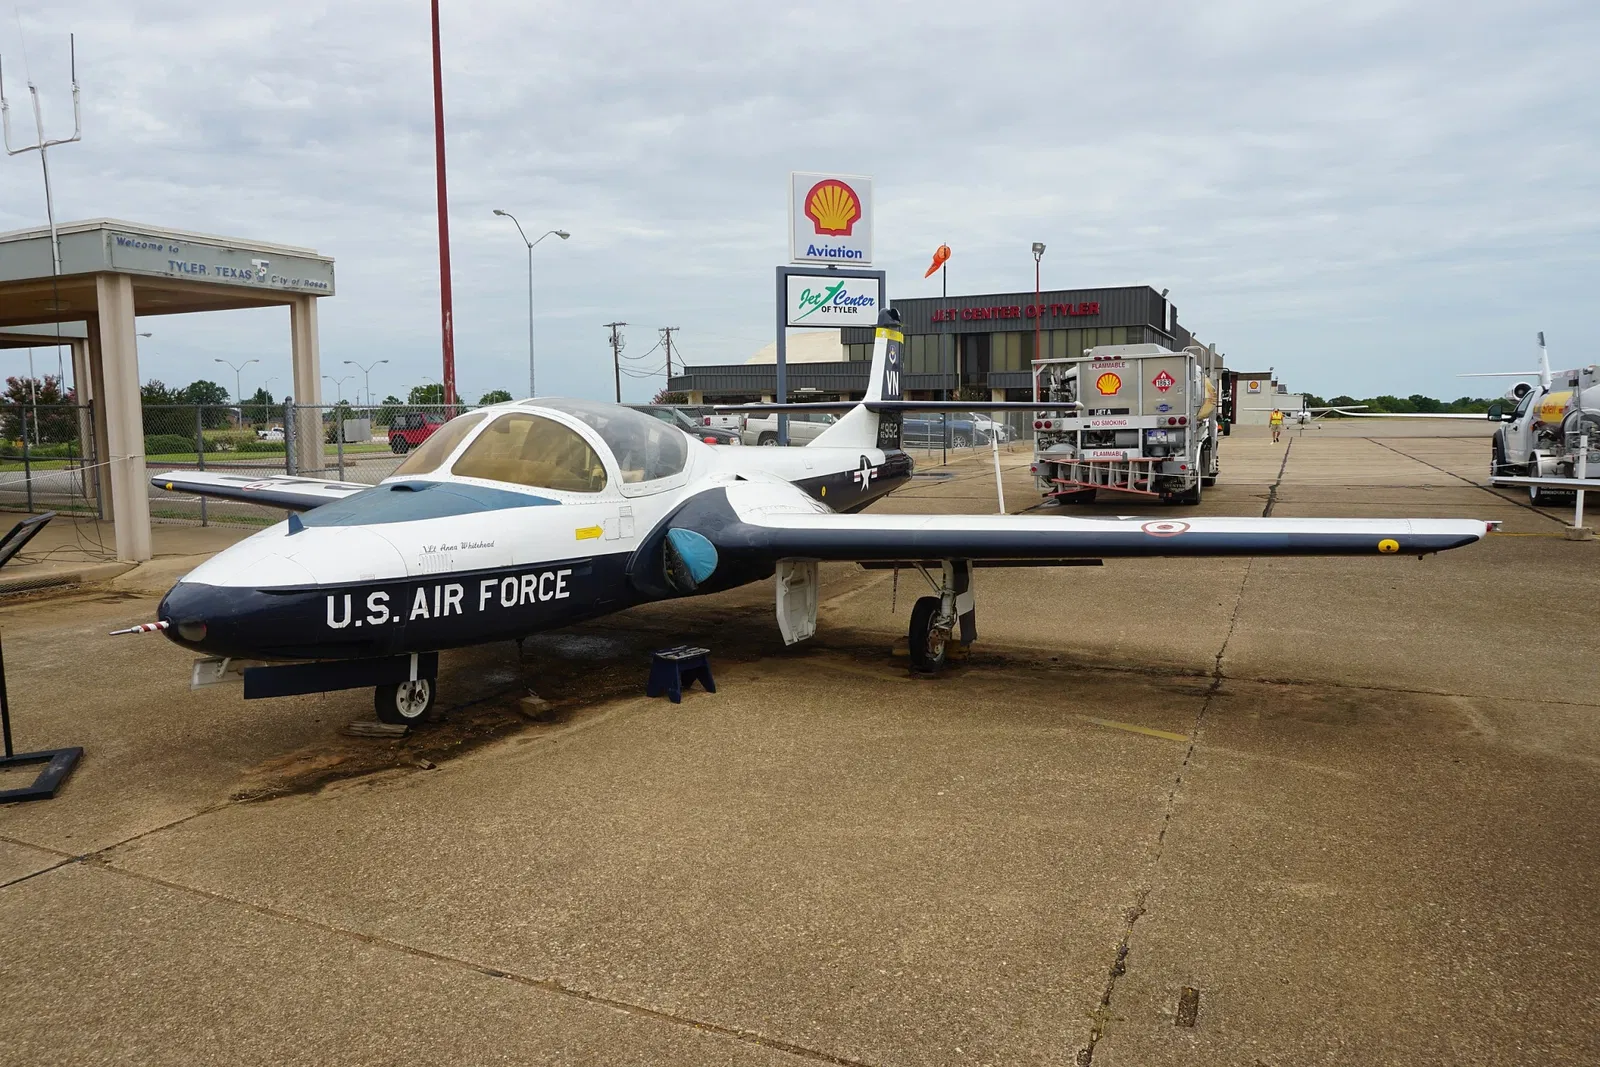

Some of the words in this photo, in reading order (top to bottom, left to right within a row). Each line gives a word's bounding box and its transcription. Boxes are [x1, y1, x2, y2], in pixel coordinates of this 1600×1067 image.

[116, 237, 163, 251] Welcome
[169, 245, 179, 253] to
[806, 244, 862, 259] Aviation
[215, 266, 252, 280] TEXAS
[291, 278, 300, 286] of
[304, 279, 328, 289] Roses
[798, 288, 822, 310] Jet
[833, 289, 875, 306] Center
[833, 306, 858, 314] TYLER
[931, 308, 958, 322] JET
[960, 305, 1021, 320] CENTER
[1024, 304, 1047, 318] OF
[1050, 302, 1100, 317] TYLER
[1092, 362, 1126, 370] FLAMMABLE
[886, 370, 899, 396] VN
[885, 423, 898, 439] 952
[460, 540, 495, 550] Whitehead
[326, 591, 400, 629] U.S.
[409, 583, 464, 621] AIR
[478, 569, 572, 612] FORCE
